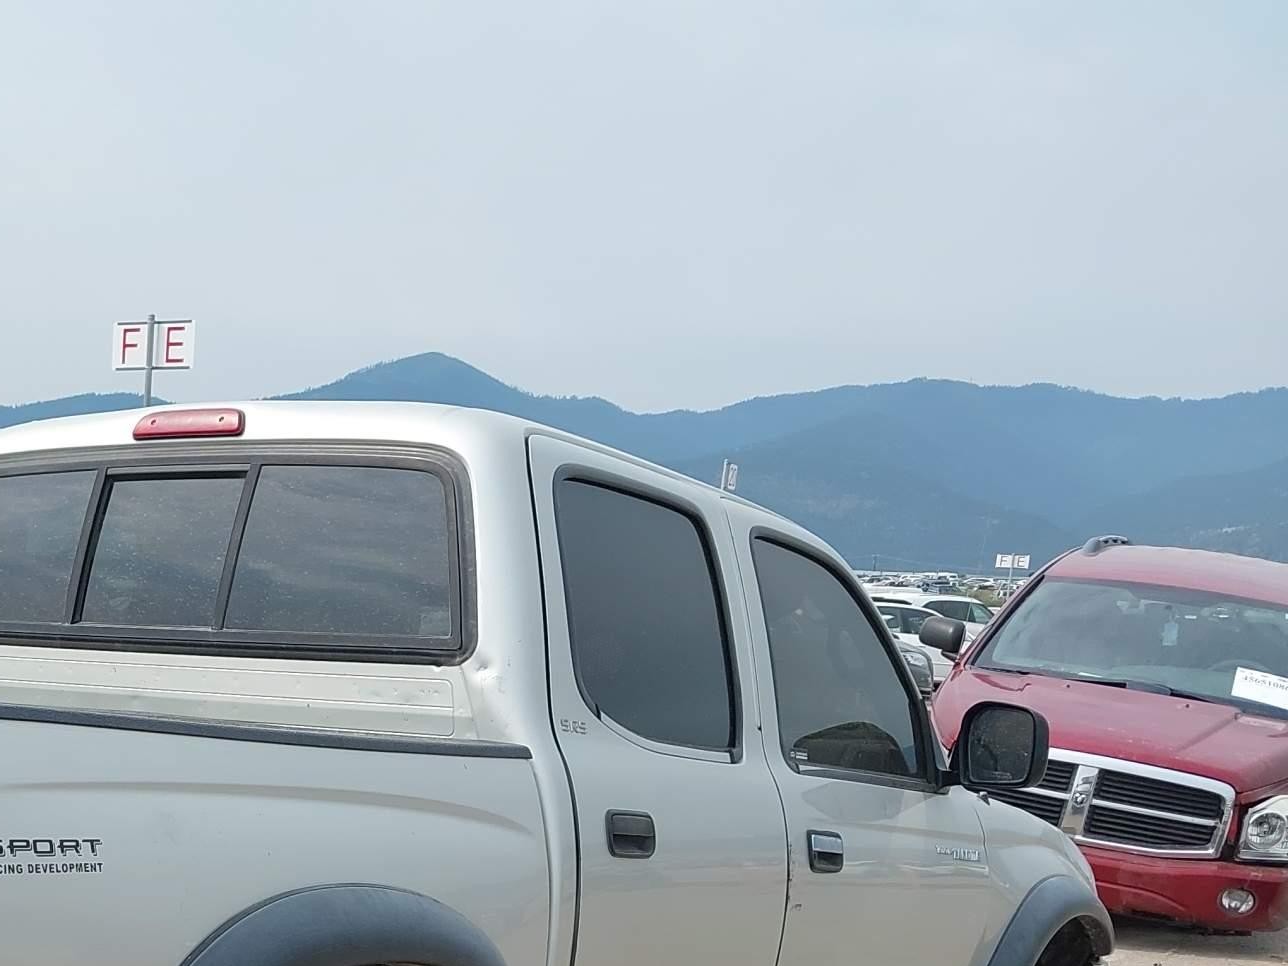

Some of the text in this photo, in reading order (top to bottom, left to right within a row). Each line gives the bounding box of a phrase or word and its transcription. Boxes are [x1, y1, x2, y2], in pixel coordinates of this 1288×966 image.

[121, 326, 185, 364] F E
[27, 862, 104, 874] DEVELOPMENT
